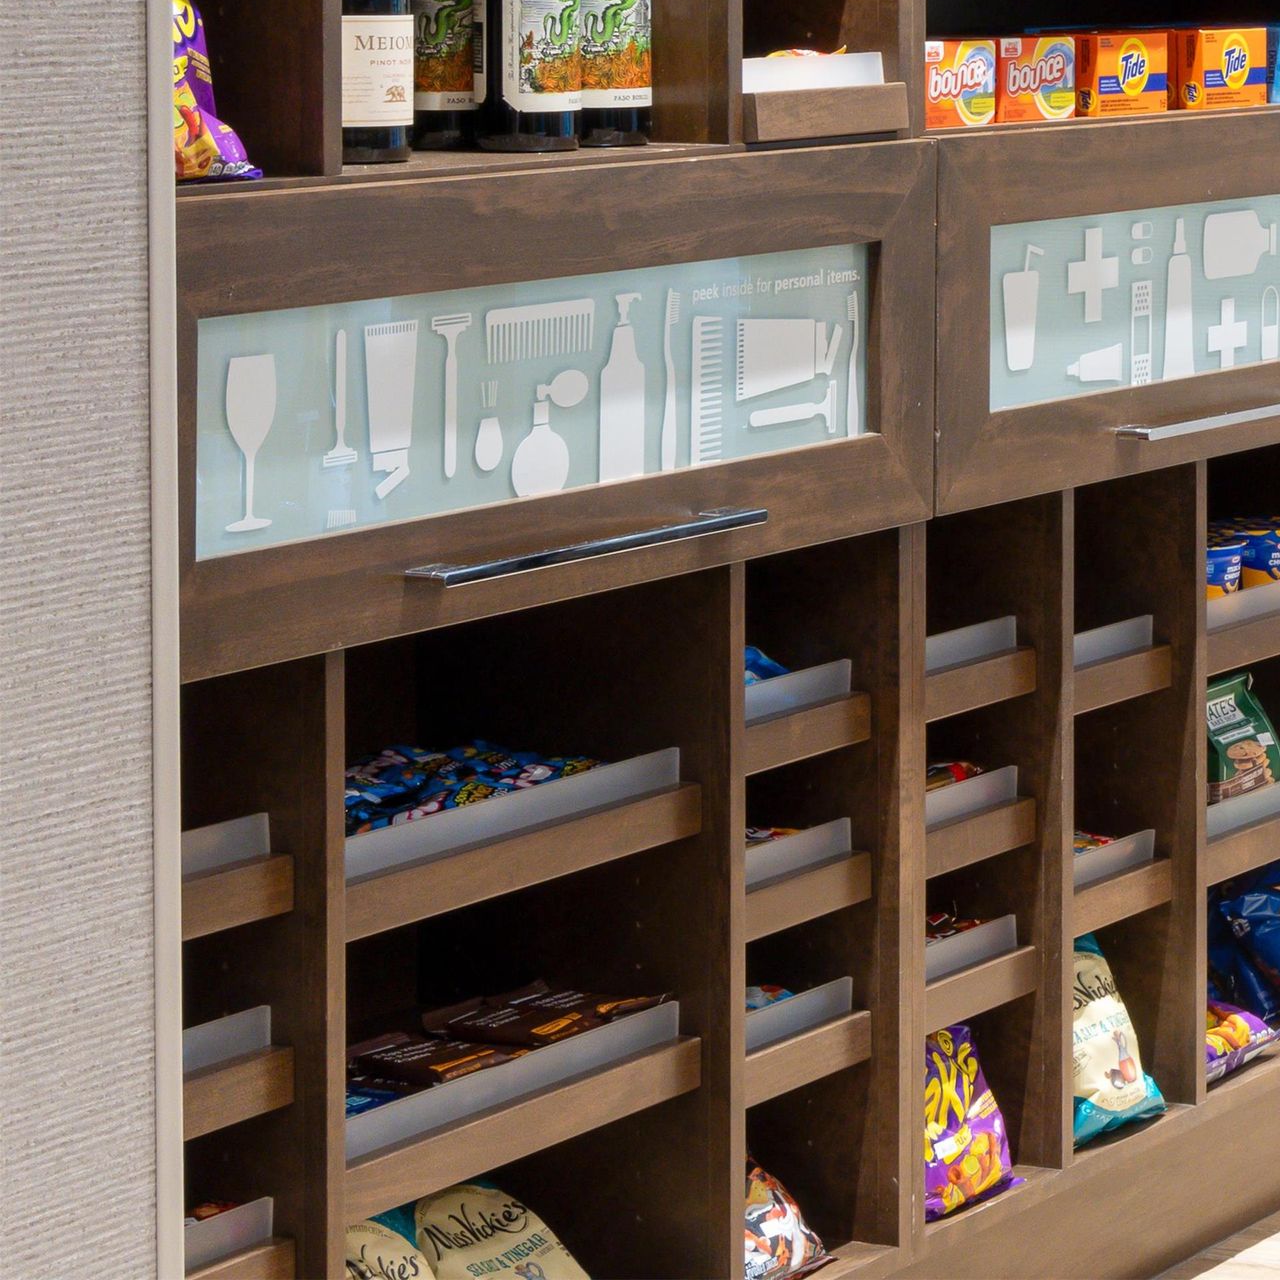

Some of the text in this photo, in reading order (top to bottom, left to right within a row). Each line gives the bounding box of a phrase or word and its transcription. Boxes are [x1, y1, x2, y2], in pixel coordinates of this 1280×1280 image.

[1007, 55, 1066, 97] bounce
[1121, 52, 1146, 86] Tide
[1223, 47, 1247, 79] Tide
[692, 269, 861, 304] peek inside for personal items.
[1207, 697, 1237, 722] ATE'S
[1076, 971, 1118, 1008] Vicki
[423, 1201, 528, 1262] Miss Vickie's
[504, 1232, 548, 1263] VINEGAR
